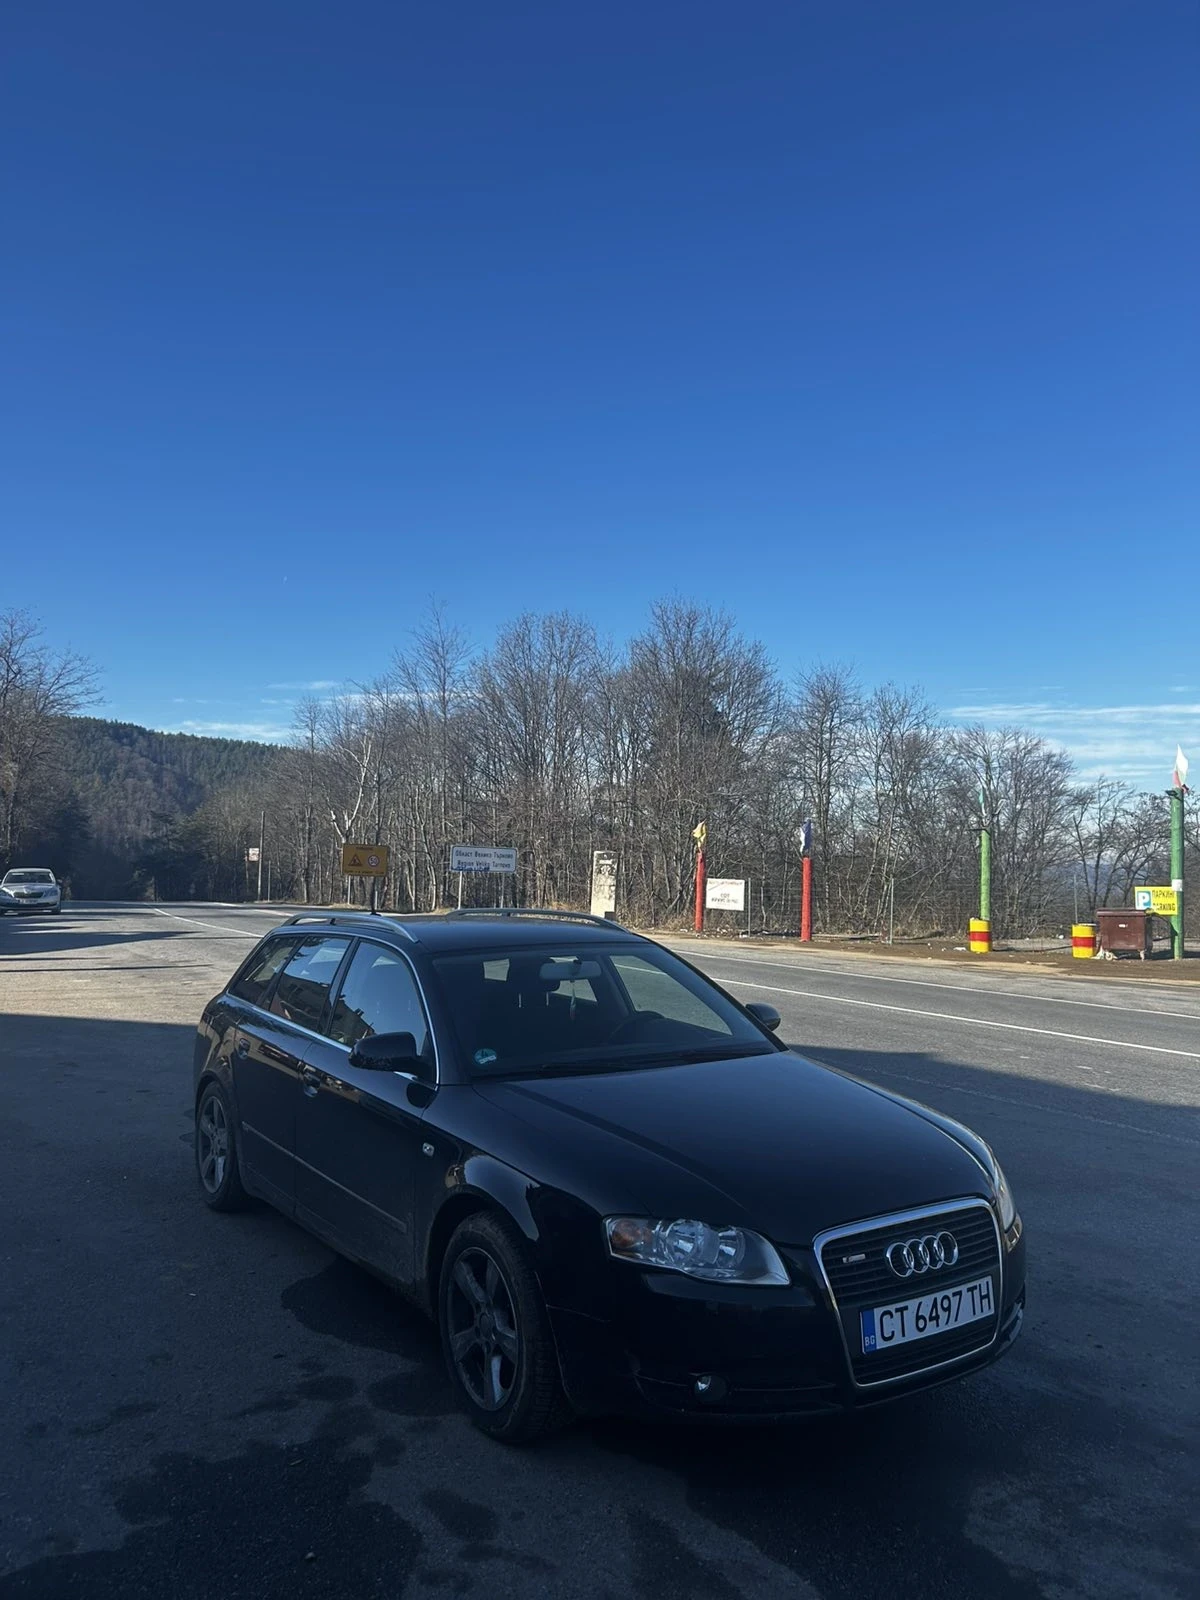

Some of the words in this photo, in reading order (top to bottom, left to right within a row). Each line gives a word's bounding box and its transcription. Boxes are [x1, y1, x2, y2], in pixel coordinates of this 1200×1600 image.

[879, 1305, 909, 1342] CT
[915, 1290, 963, 1333] 6497
[966, 1280, 992, 1316] TH
[864, 1335, 876, 1347] BG
